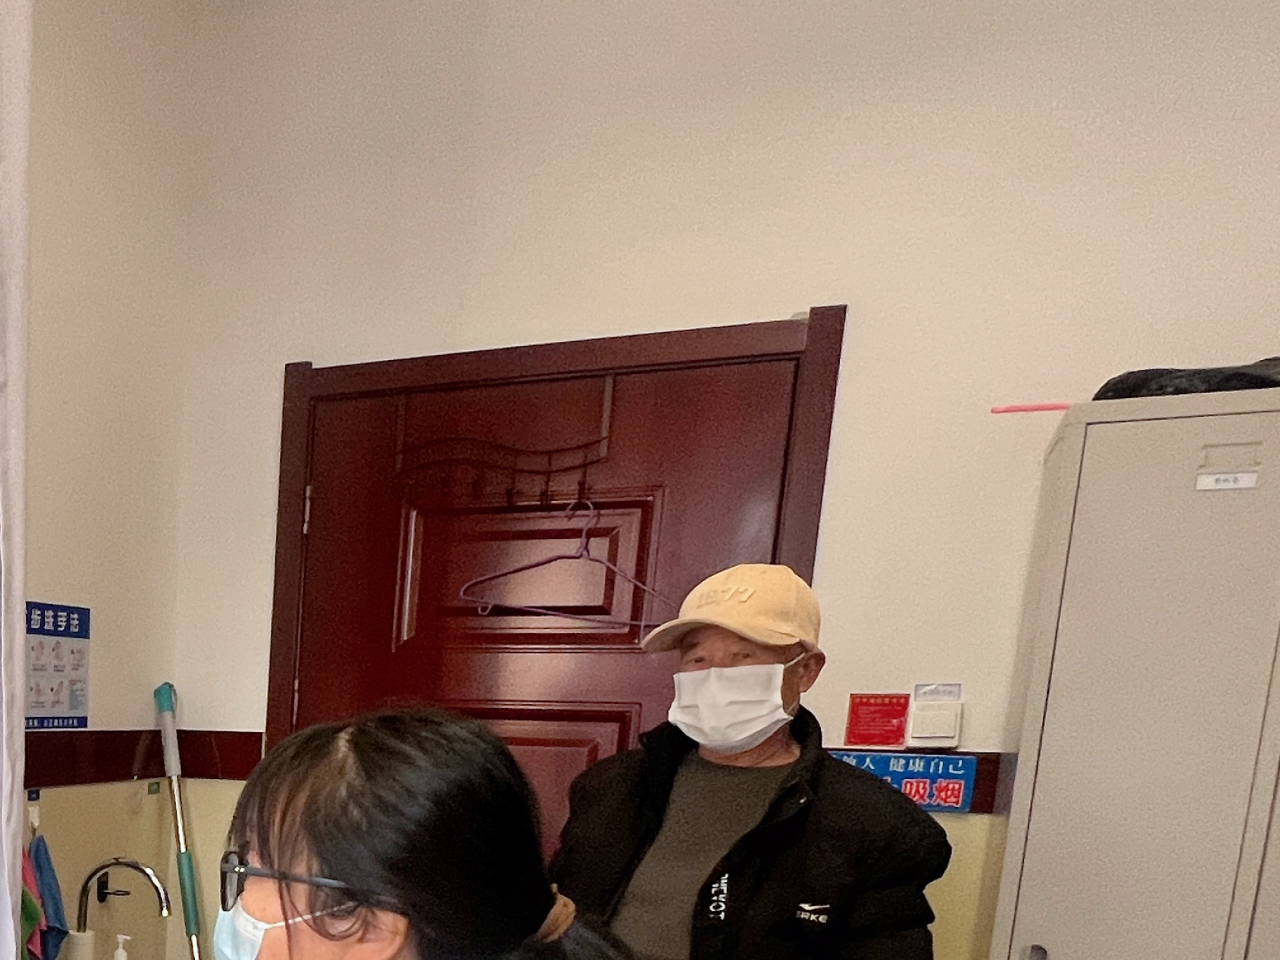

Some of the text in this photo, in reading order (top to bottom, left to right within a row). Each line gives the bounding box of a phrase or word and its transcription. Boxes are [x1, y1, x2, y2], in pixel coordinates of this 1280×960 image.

[889, 757, 965, 775] 健康自己
[883, 776, 965, 808] 吸烟
